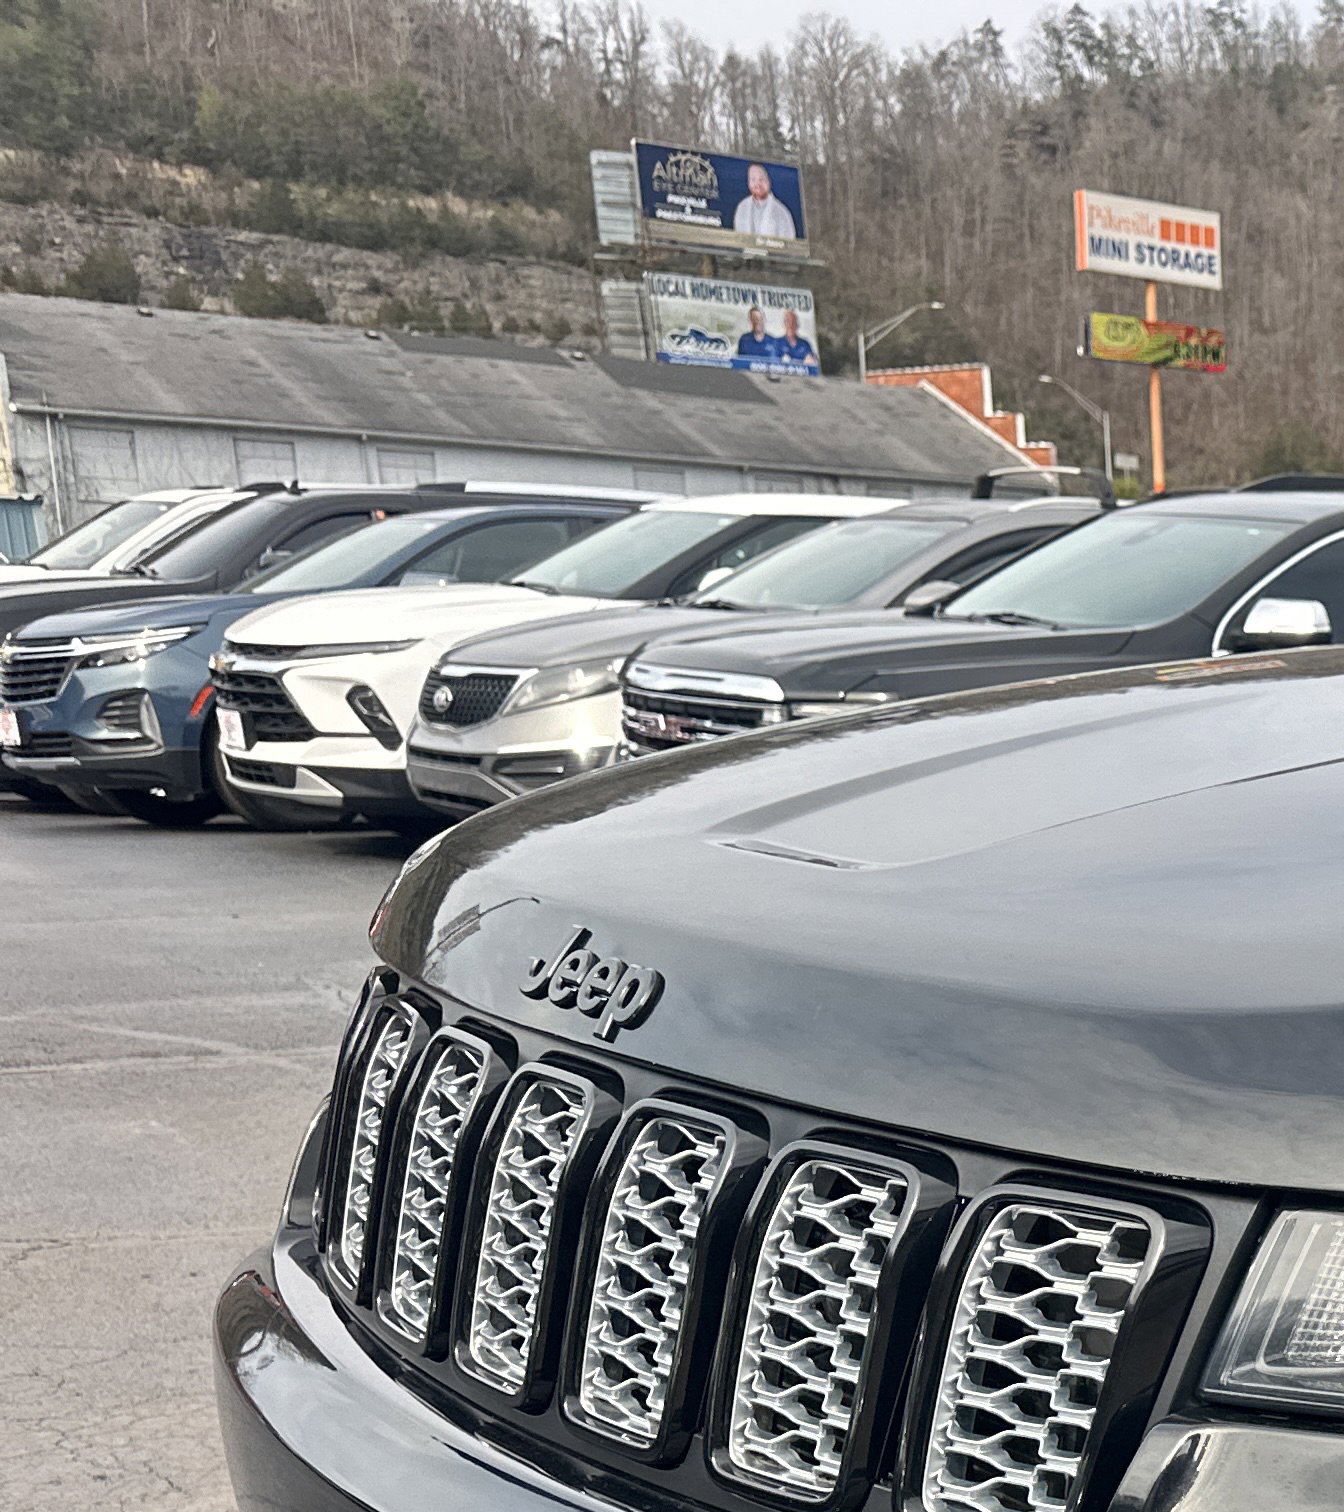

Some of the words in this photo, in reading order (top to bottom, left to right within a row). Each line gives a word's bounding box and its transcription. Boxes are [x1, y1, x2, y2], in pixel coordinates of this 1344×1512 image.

[1090, 235, 1130, 261] MINI
[1135, 241, 1217, 276] STORAGE
[761, 288, 813, 312] TRUSTED
[519, 924, 666, 1044] Jeep
